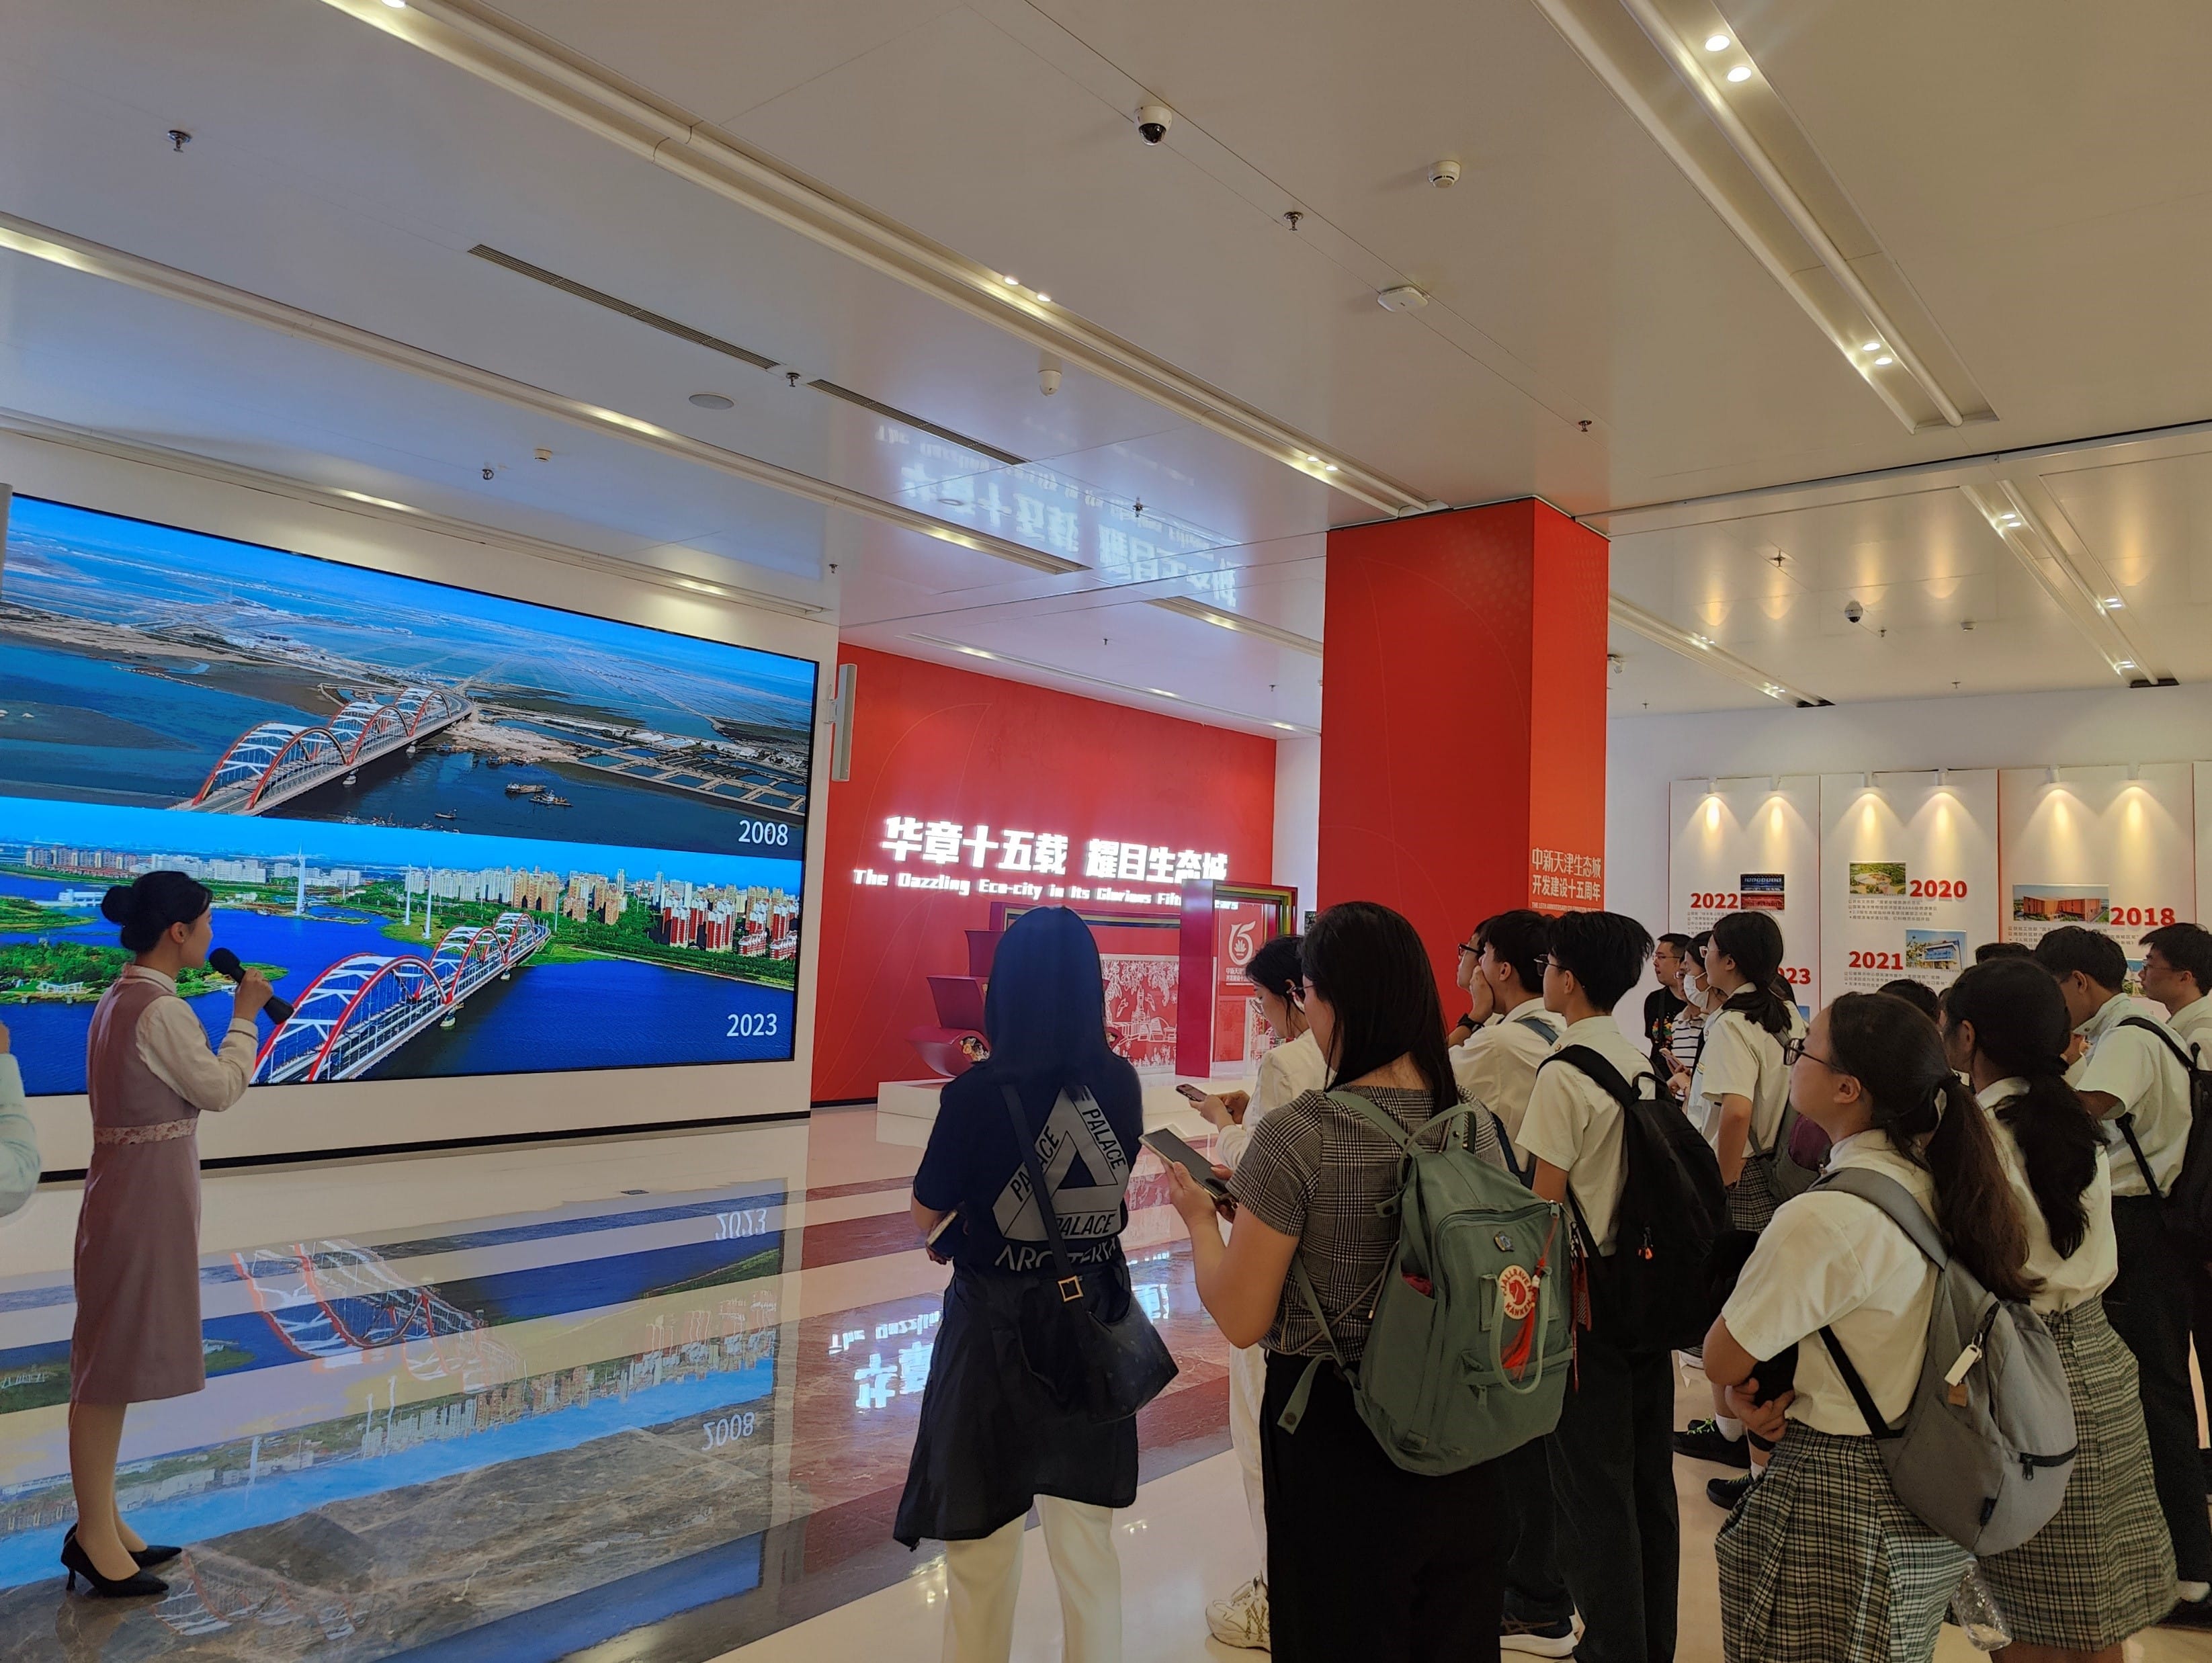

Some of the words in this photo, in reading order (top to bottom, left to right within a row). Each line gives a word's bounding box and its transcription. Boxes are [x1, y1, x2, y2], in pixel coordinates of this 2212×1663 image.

[738, 820, 788, 846] 2008
[881, 816, 1068, 875] 华章十五载
[1532, 847, 1601, 879] 中新天津生态城
[853, 869, 889, 886] The
[898, 873, 971, 896] Dazzling
[978, 879, 1043, 900] Eco-city
[1050, 884, 1064, 898] in
[1071, 886, 1090, 899] Its
[1097, 888, 1152, 904] Glorious
[1532, 874, 1601, 901] 开发建设十五周年
[1691, 892, 1738, 908] 2022
[1910, 880, 1967, 898] 2020
[2110, 907, 2176, 927] 2018
[1848, 951, 1904, 970] 2021
[726, 1013, 777, 1037] 2023
[1082, 1108, 1126, 1170] PALACE
[1010, 1125, 1060, 1202] PAACE
[994, 1238, 1117, 1271] ARCTERYX
